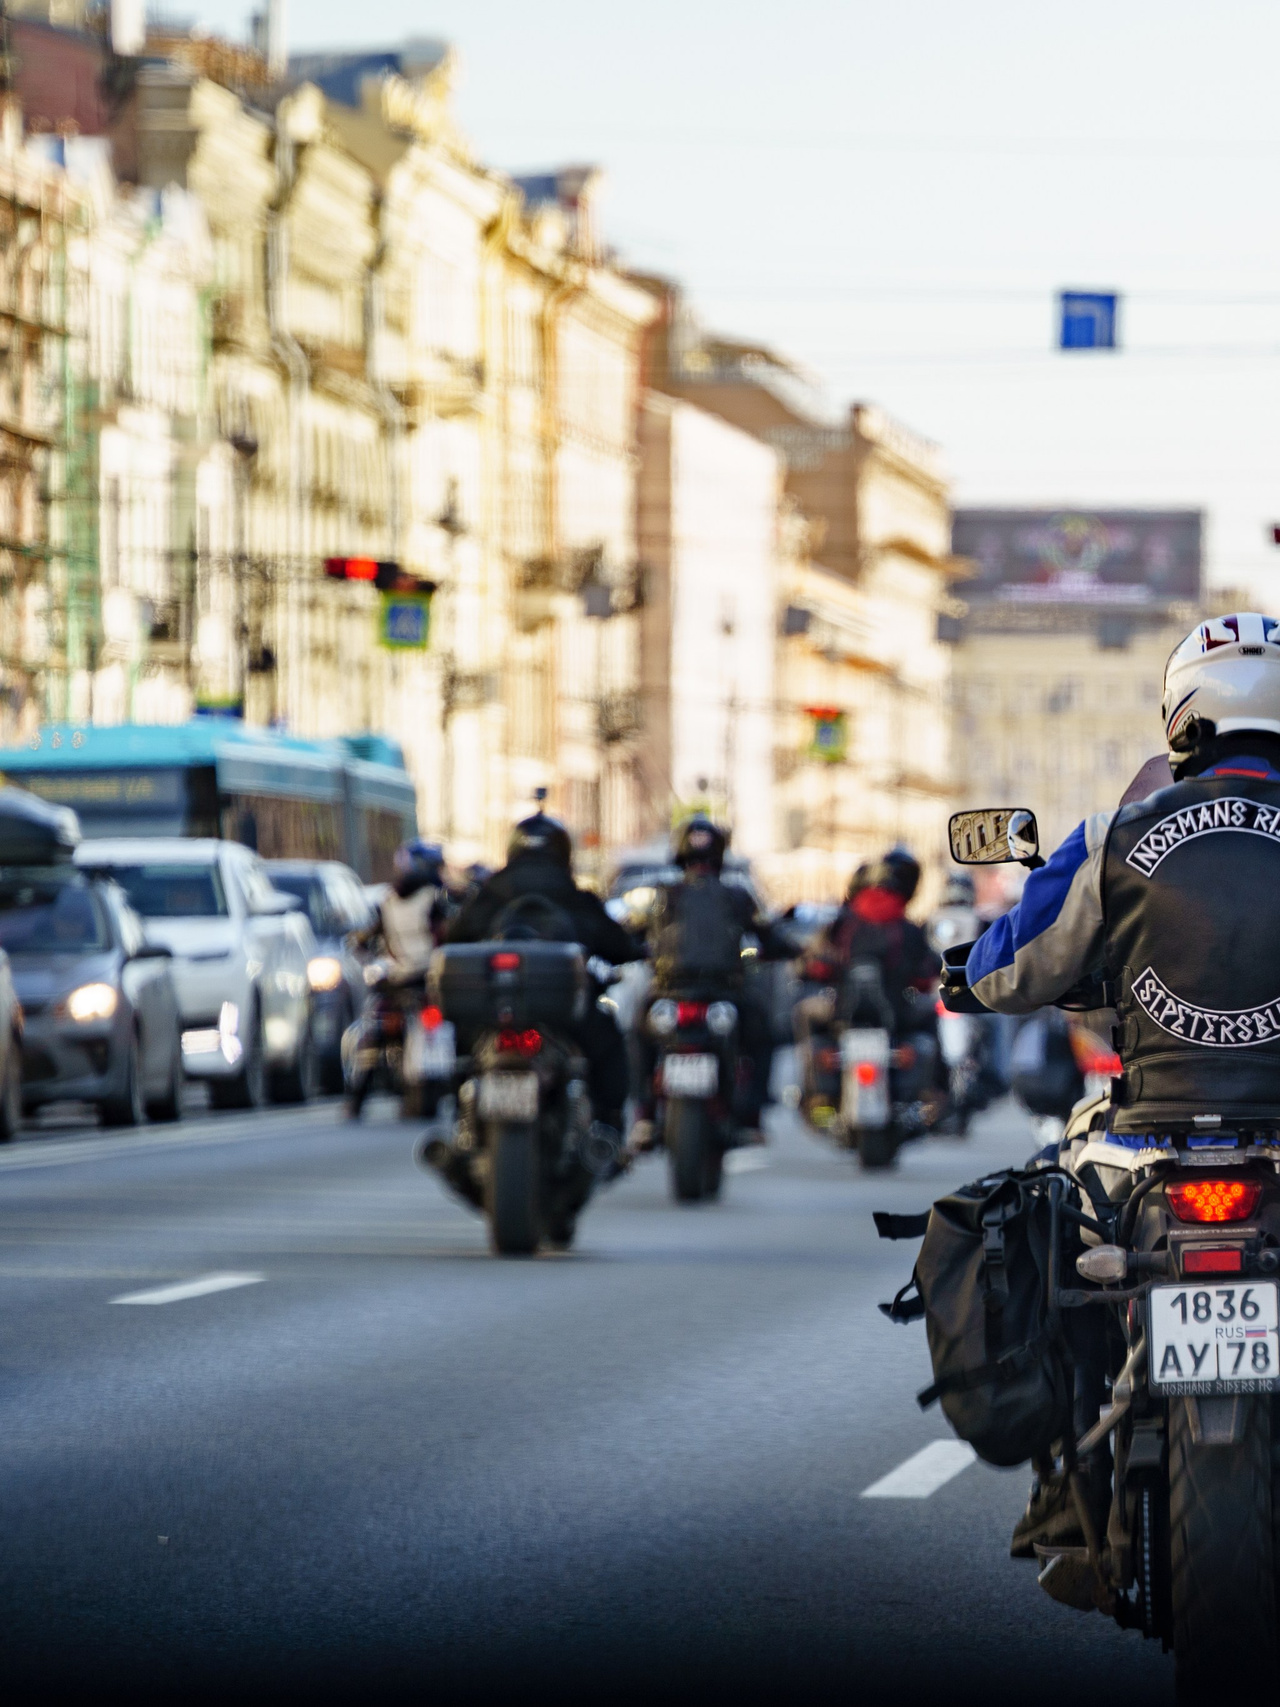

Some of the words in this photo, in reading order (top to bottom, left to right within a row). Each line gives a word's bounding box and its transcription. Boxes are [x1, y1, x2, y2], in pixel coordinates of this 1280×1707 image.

[1133, 800, 1248, 868] NORMANS
[1170, 1288, 1260, 1325] 1836
[1215, 1326, 1244, 1339] RUS
[1226, 1341, 1271, 1375] 78
[1161, 1381, 1212, 1396] NORMANS
[1216, 1379, 1255, 1394] RIDERS
[1258, 1379, 1274, 1392] MC
